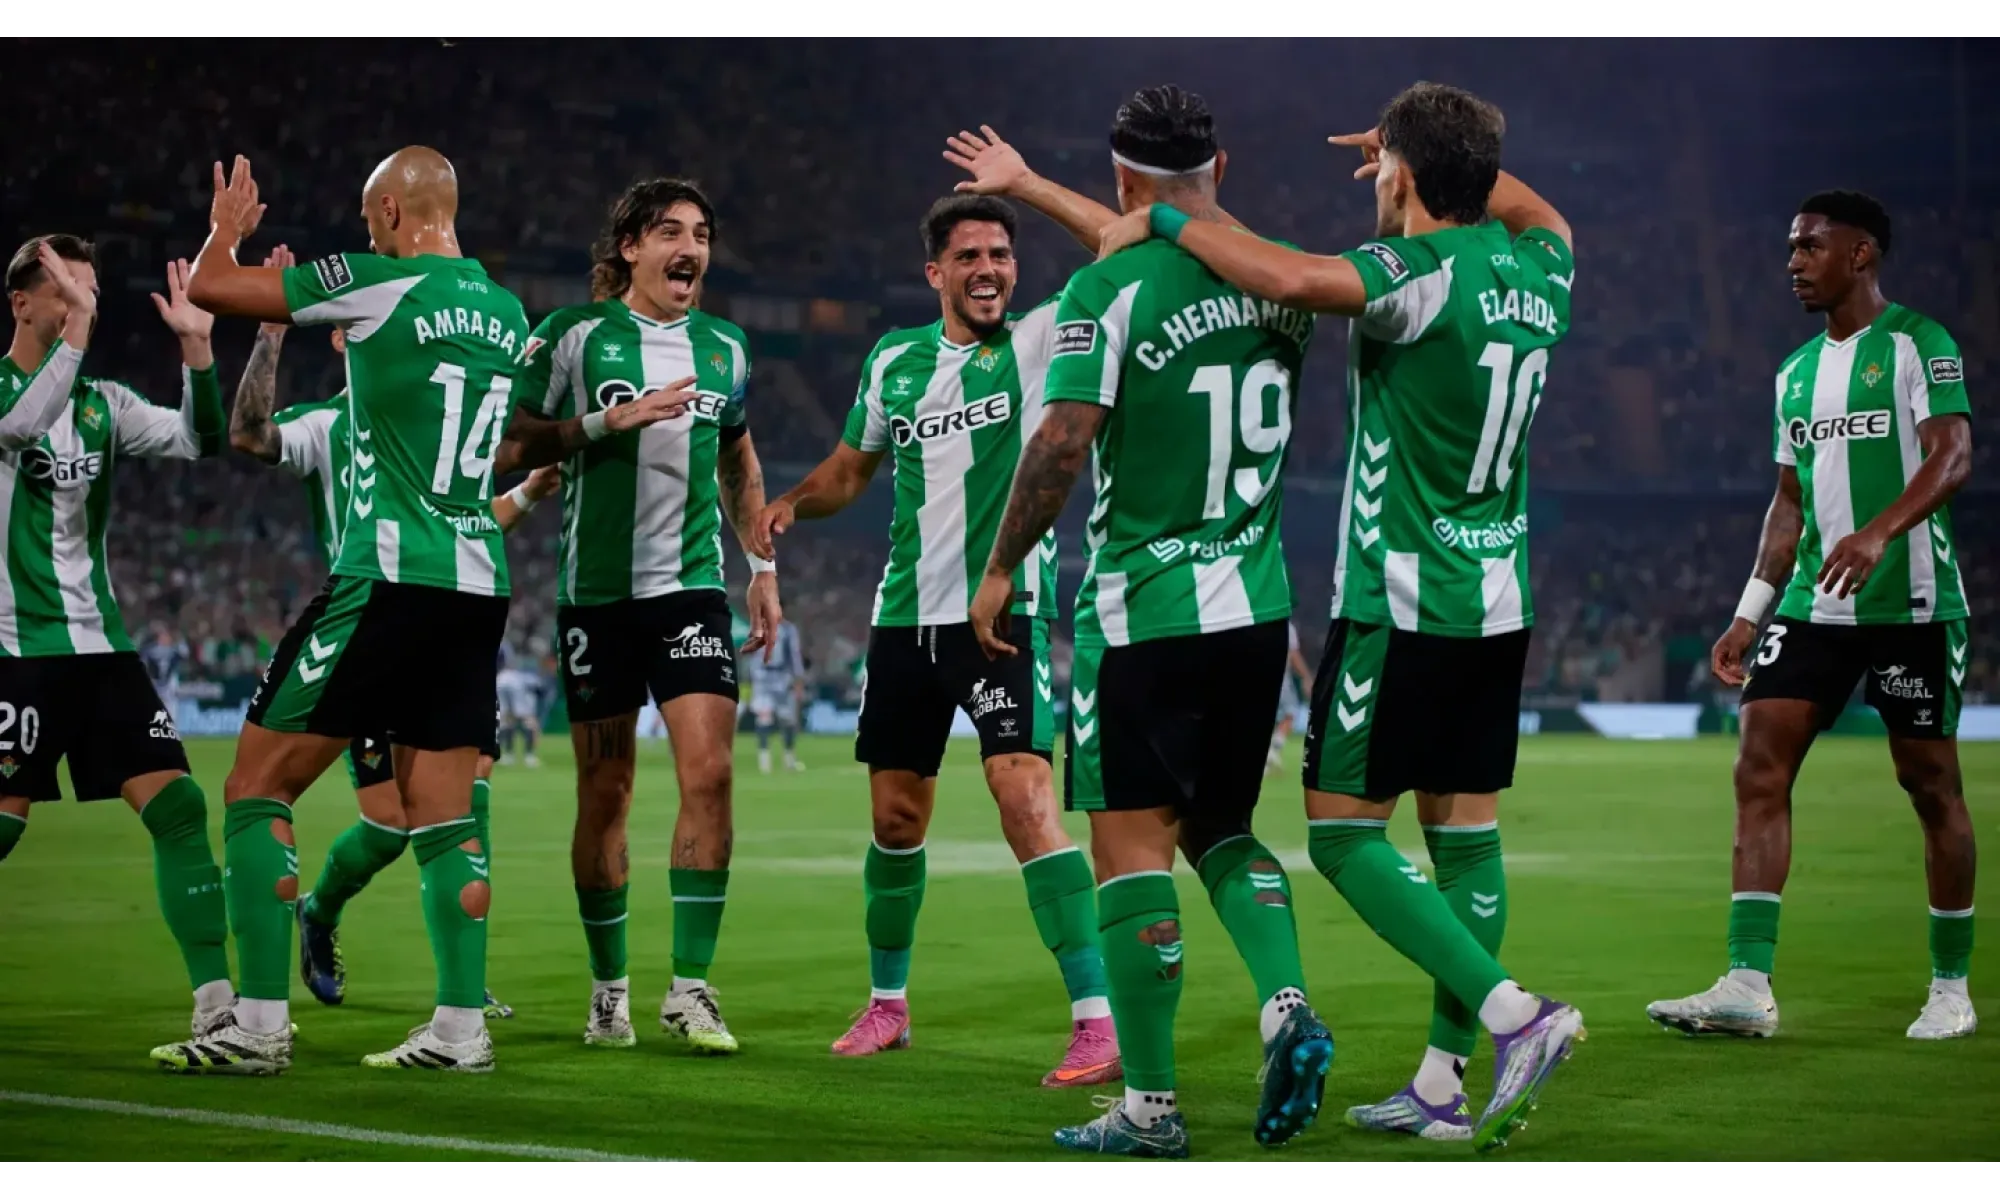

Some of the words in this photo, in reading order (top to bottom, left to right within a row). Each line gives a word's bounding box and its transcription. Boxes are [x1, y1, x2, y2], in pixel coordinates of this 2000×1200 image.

[428, 361, 513, 501] 14
[916, 395, 1008, 439] GREE
[1187, 358, 1293, 520] 19
[1466, 341, 1549, 494] 10
[1810, 412, 1889, 441] GREE
[566, 626, 593, 676] 2
[669, 646, 733, 661] GLOBAL
[689, 636, 723, 648] AUS
[977, 686, 1005, 705] AUS
[1892, 677, 1924, 688] AUS
[0, 701, 40, 755] 20
